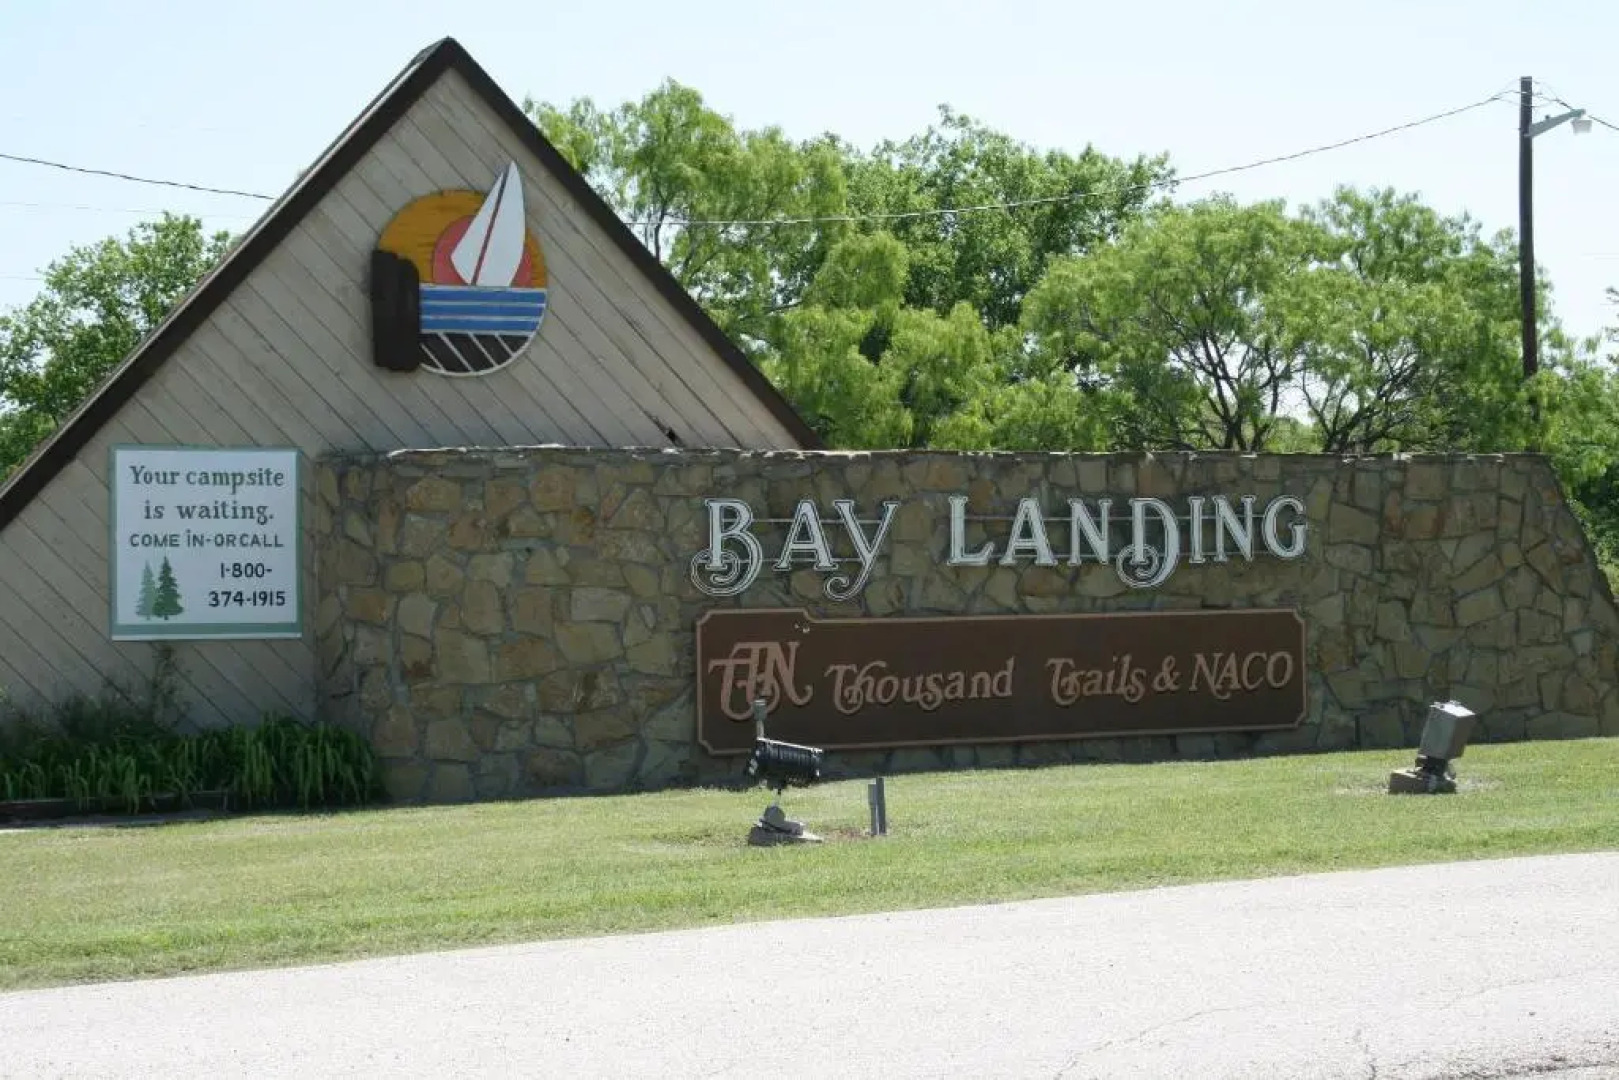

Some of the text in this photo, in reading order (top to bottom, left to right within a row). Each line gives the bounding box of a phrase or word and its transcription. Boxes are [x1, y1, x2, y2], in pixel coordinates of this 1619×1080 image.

[129, 465, 284, 495] Your campsite
[144, 500, 274, 526] is waiting.
[129, 533, 180, 547] COME
[690, 494, 1309, 600] BAY LANDING
[208, 590, 286, 607] 374-1915
[824, 655, 1016, 714] Thousand
[1045, 652, 1148, 706] Trails
[1152, 655, 1182, 692] &
[1188, 650, 1294, 700] NACO
